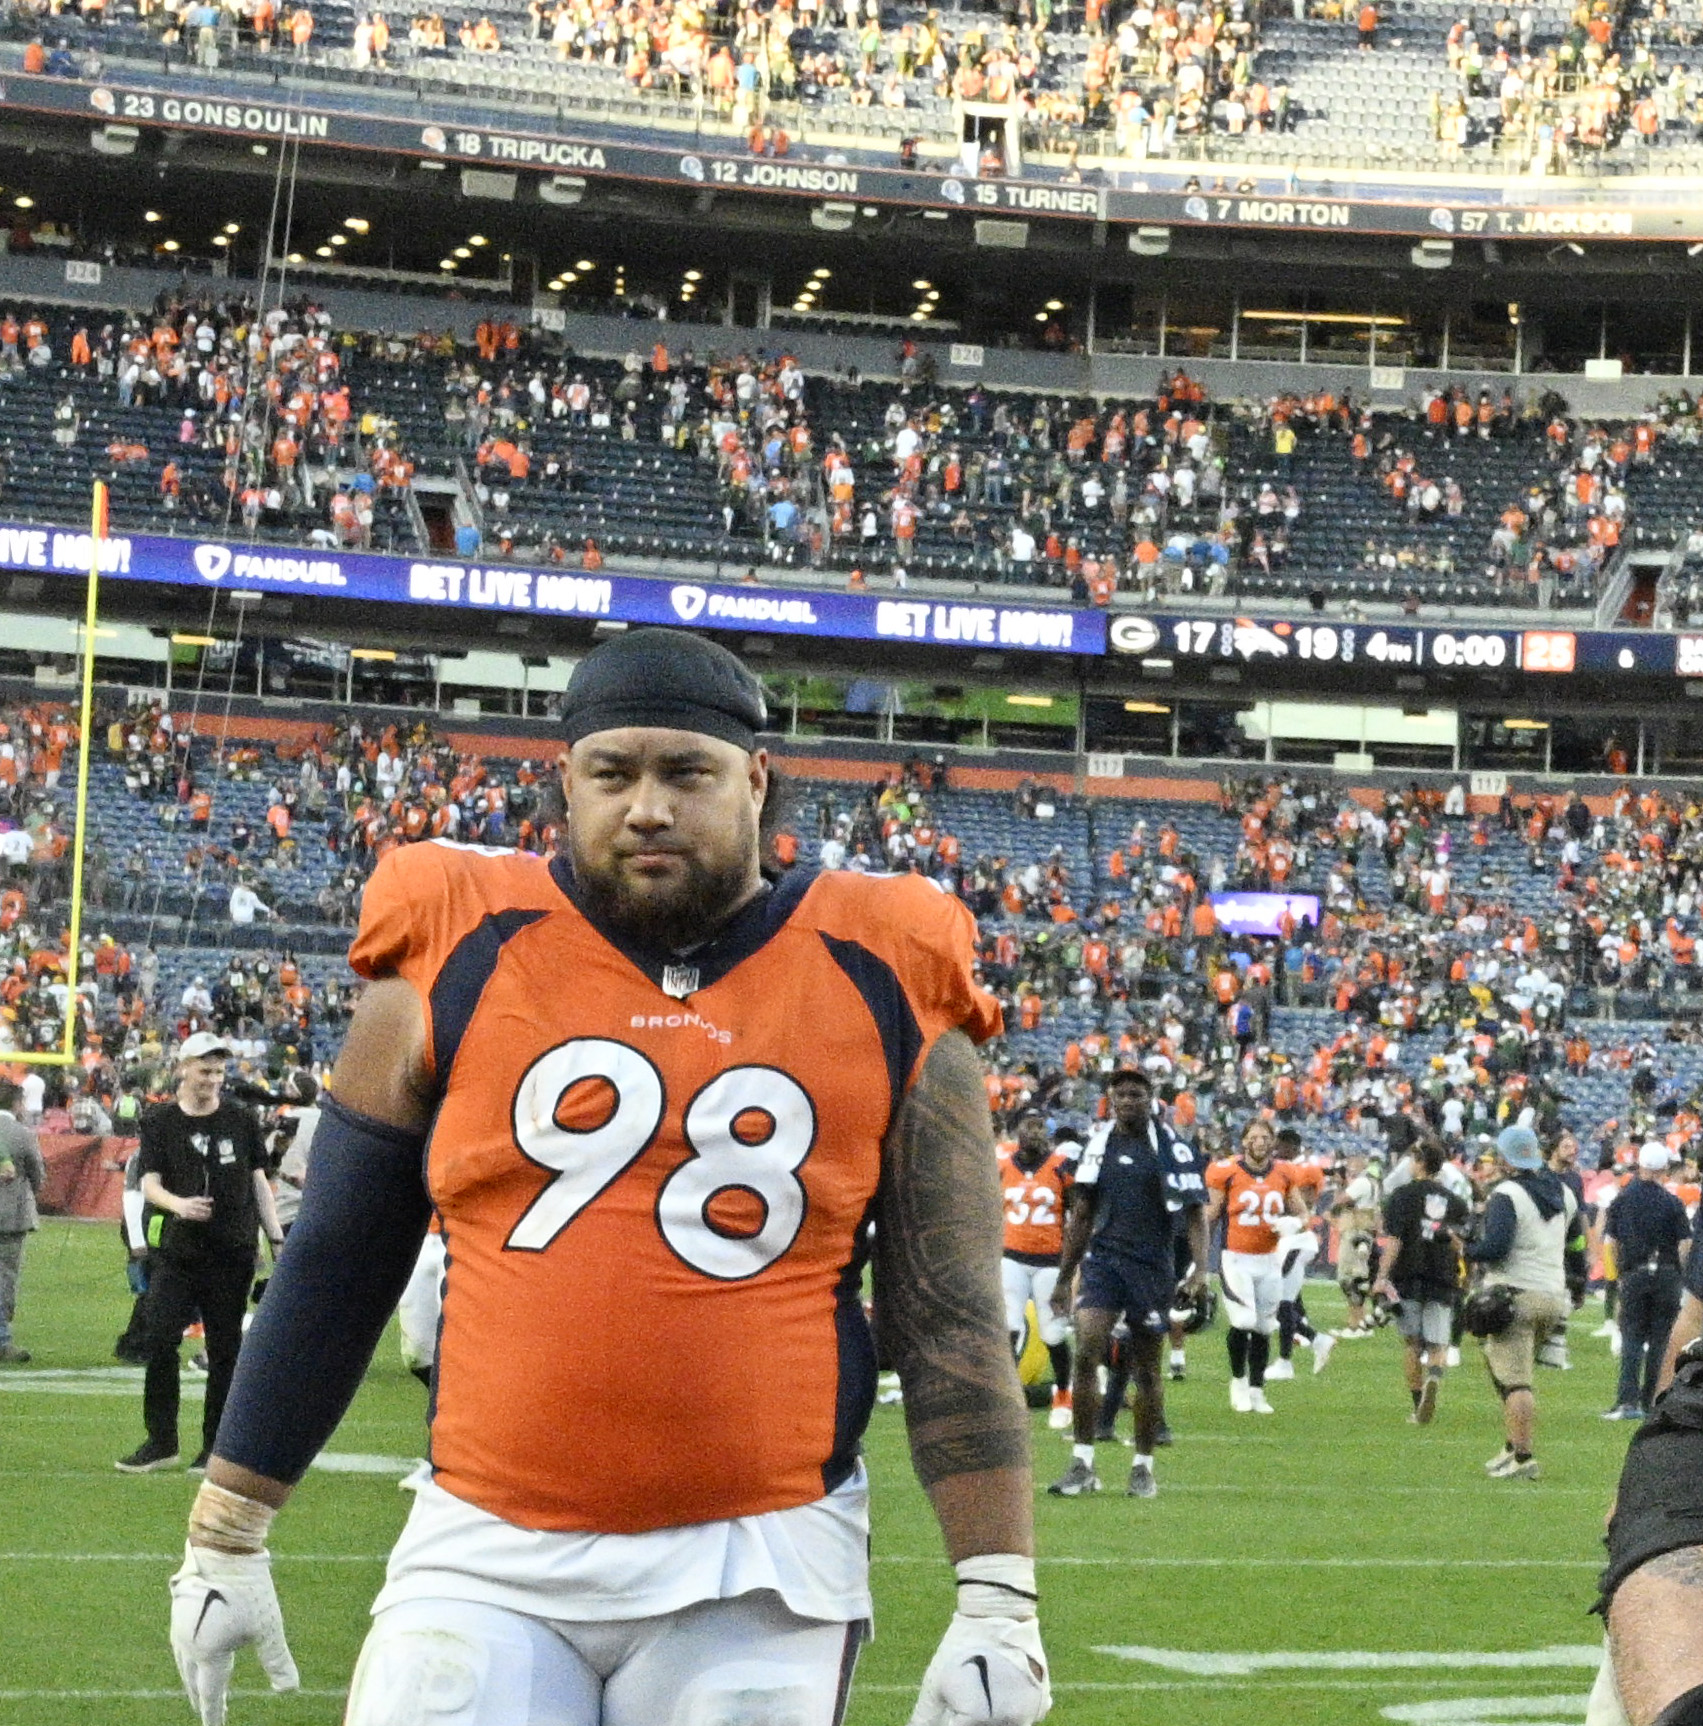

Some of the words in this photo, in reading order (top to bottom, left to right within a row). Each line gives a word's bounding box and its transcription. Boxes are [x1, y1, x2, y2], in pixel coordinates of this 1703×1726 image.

[123, 95, 155, 118] 23
[163, 100, 329, 138] GONSOULIN
[455, 132, 481, 155] 18
[487, 136, 607, 170] TRIPUCKA
[711, 160, 738, 183] 12
[743, 164, 859, 193] JOHNSON
[974, 184, 998, 205] 15
[1006, 186, 1097, 214] TURNER
[1217, 199, 1230, 220] 7
[1238, 200, 1350, 226] MORTON
[1460, 212, 1489, 233] 57
[1517, 212, 1634, 235] JACKSON
[52, 533, 131, 573] NOW!
[233, 554, 347, 586] FANDUEL
[409, 563, 465, 602] BET
[469, 568, 533, 608] LIVE
[535, 575, 613, 613] NOW!
[708, 594, 818, 624] FANDUEL
[876, 600, 931, 638] BET
[933, 605, 995, 643] LIVE
[999, 609, 1073, 648] NOW!
[1173, 620, 1217, 654] 17
[1294, 626, 1339, 660] 19
[1432, 633, 1506, 667] 0:00
[1527, 635, 1572, 669] 25
[501, 1035, 818, 1281] 98
[1003, 1187, 1057, 1226] 32
[1237, 1190, 1284, 1227] 20
